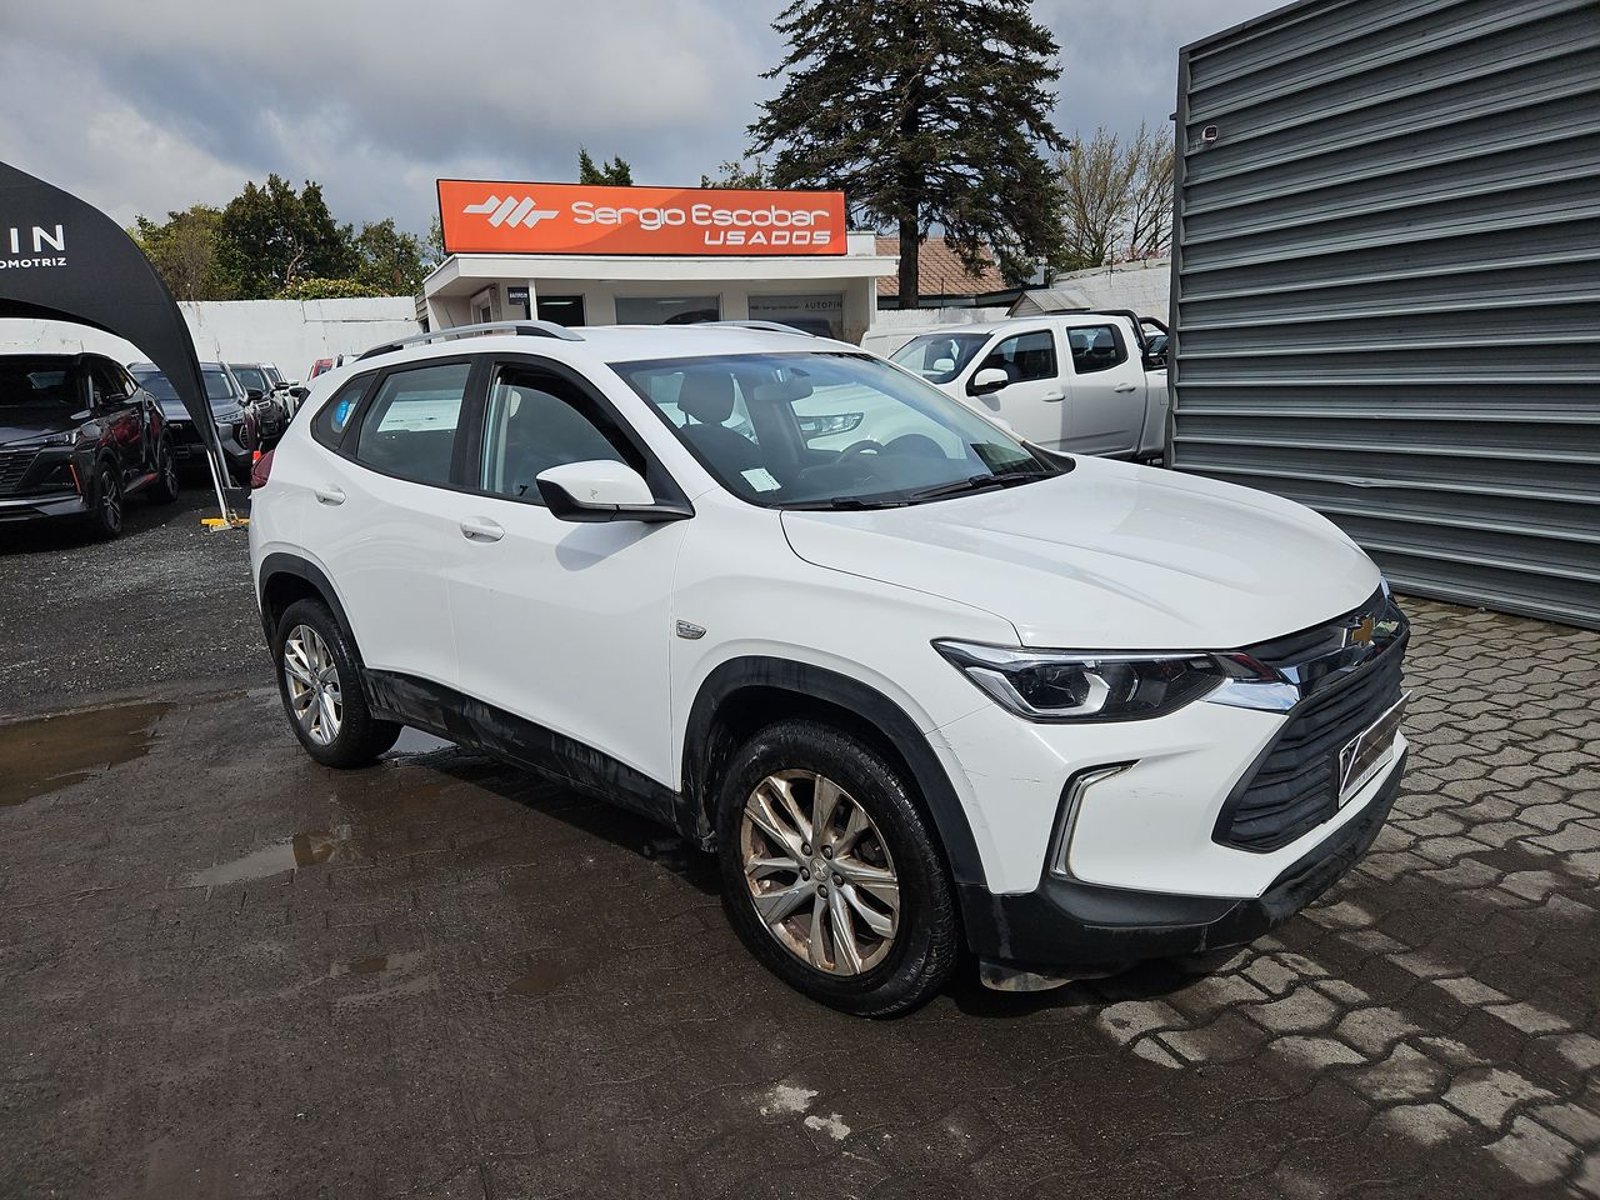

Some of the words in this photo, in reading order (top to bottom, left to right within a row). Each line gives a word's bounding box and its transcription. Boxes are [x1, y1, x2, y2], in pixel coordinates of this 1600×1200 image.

[572, 202, 686, 230] Sergio
[691, 203, 830, 228] Escobar
[704, 230, 832, 246] USADOS
